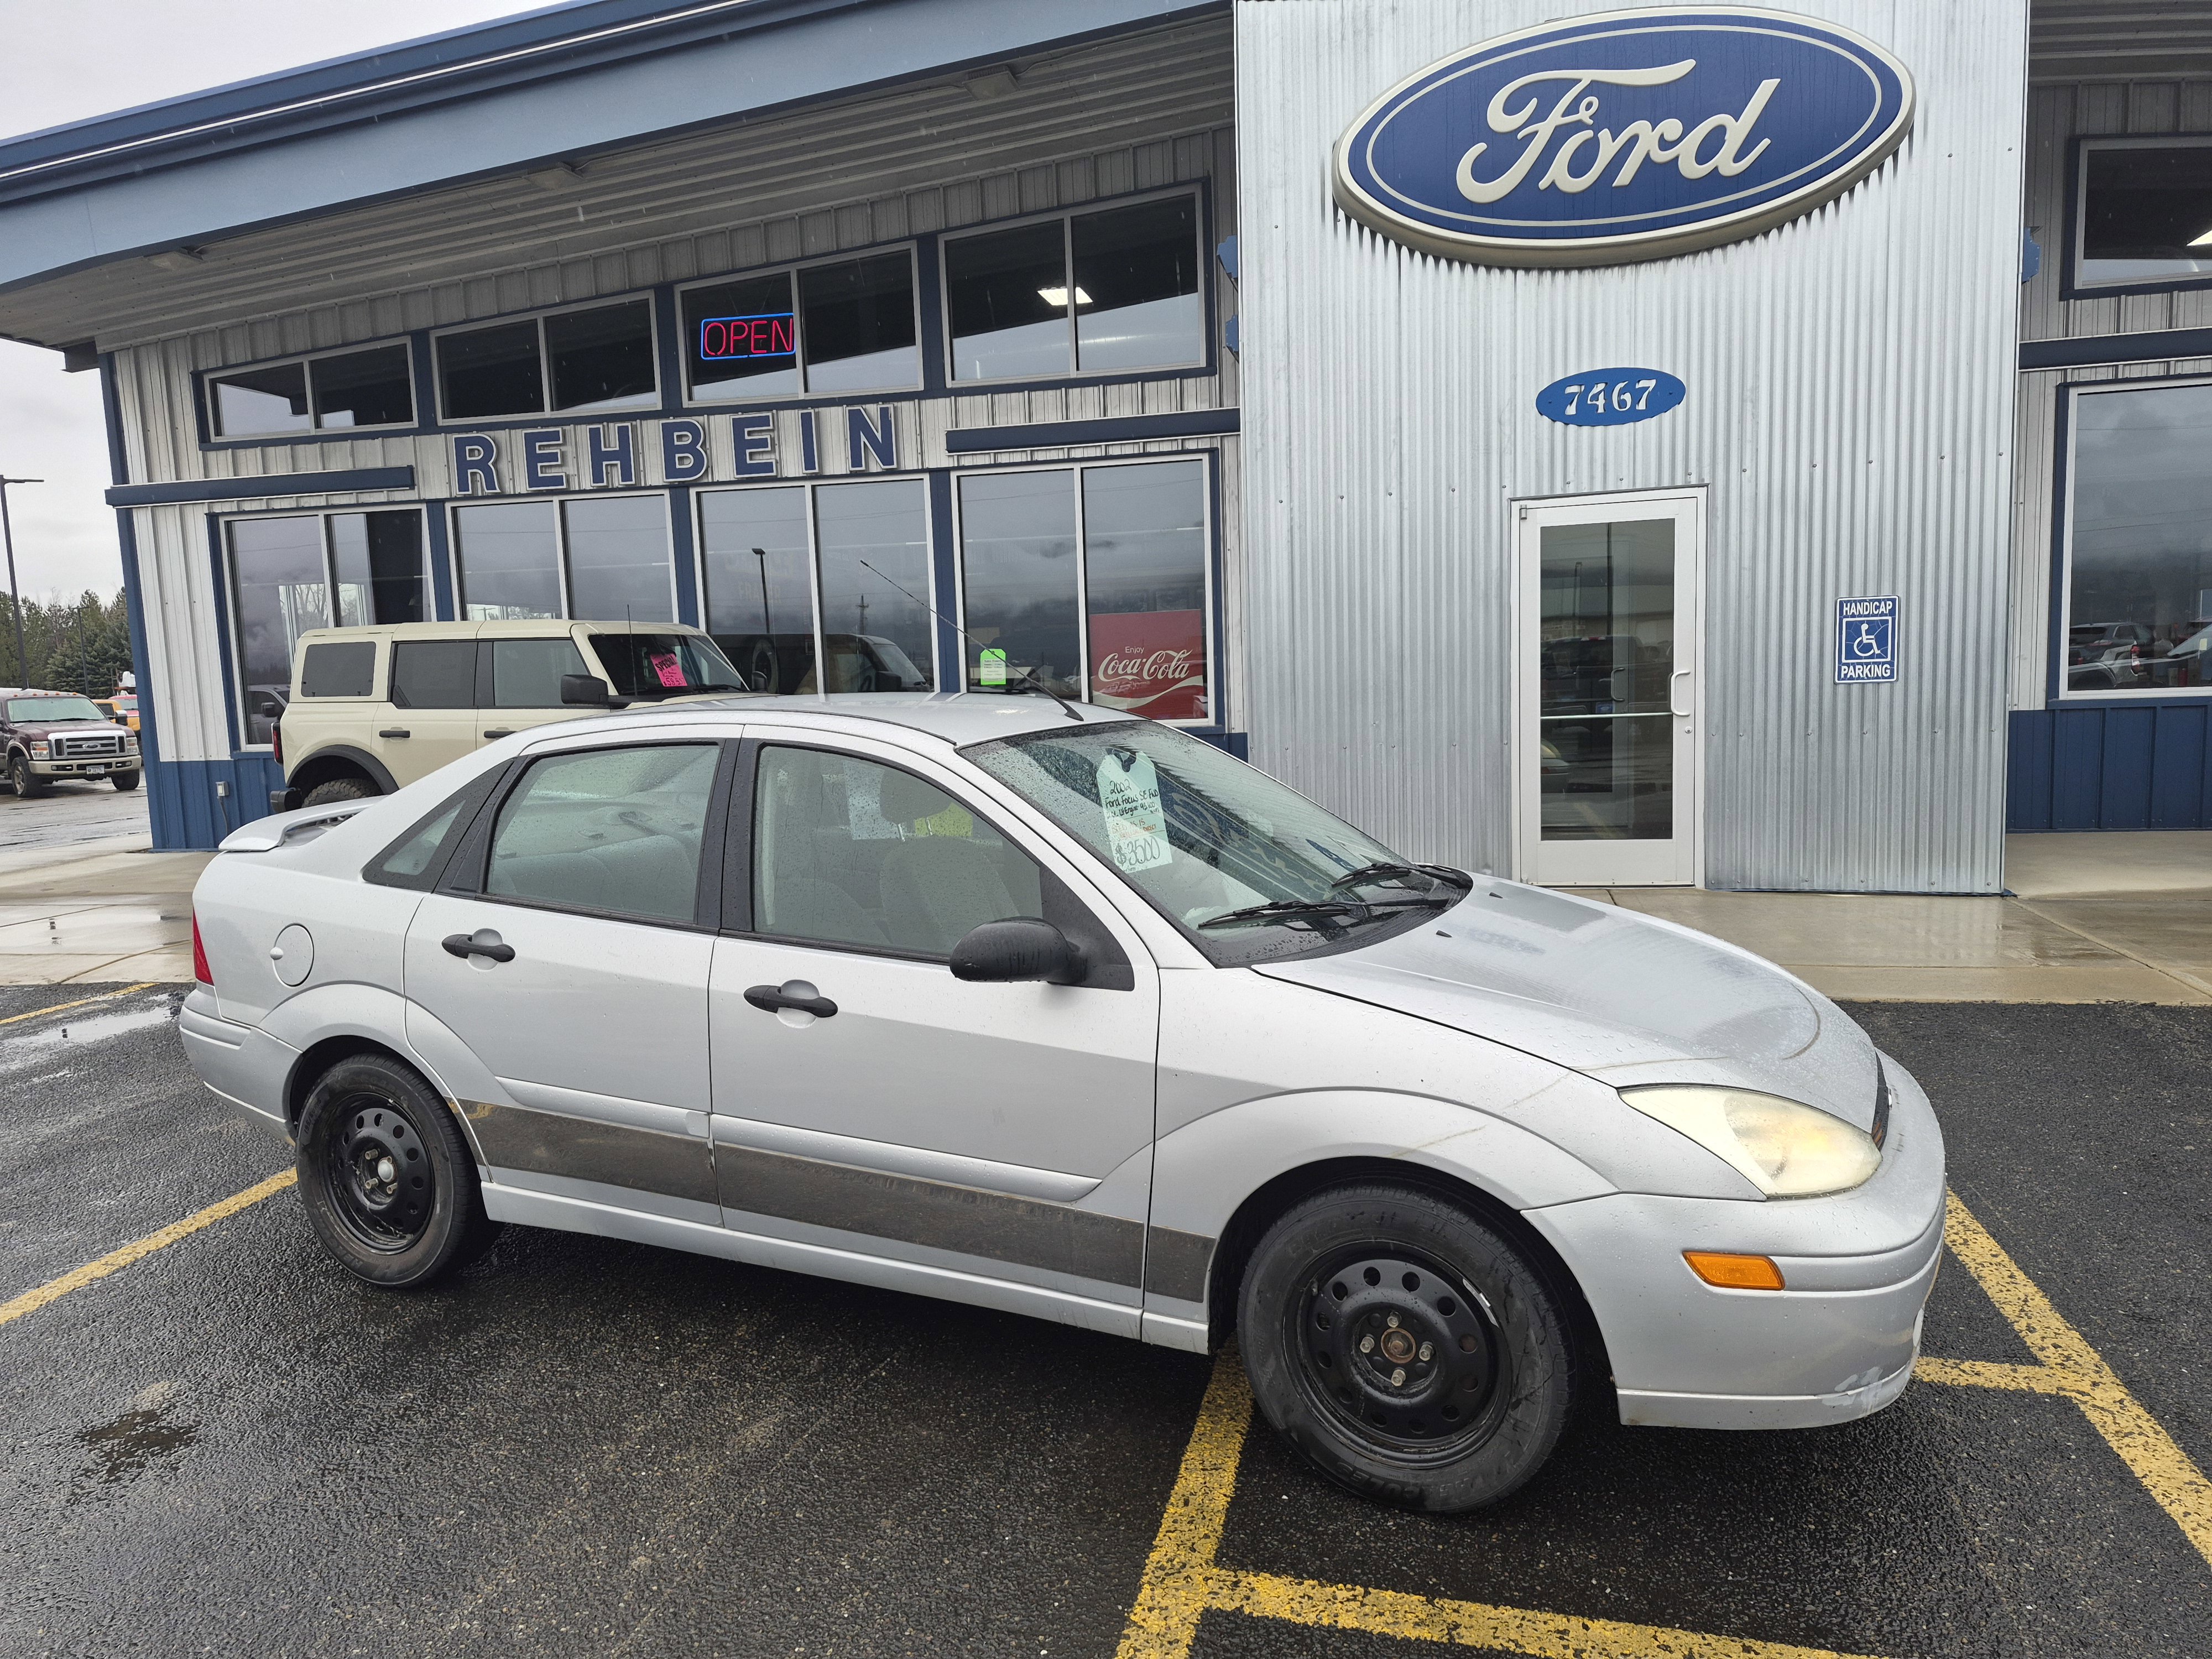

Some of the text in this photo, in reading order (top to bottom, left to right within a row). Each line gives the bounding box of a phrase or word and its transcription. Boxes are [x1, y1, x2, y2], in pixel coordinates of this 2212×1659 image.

[1456, 59, 1781, 204] Ford
[703, 319, 795, 356] OPEN
[1564, 379, 1657, 415] 7467
[452, 403, 898, 495] REHBEIN
[1843, 601, 1893, 616] HANDICAP
[1098, 649, 1193, 682] Coca-Cola
[1841, 664, 1891, 679] PARKING
[1105, 796, 1121, 809] Ford
[1109, 779, 1132, 795] 2002
[1115, 836, 1160, 867] $3500
